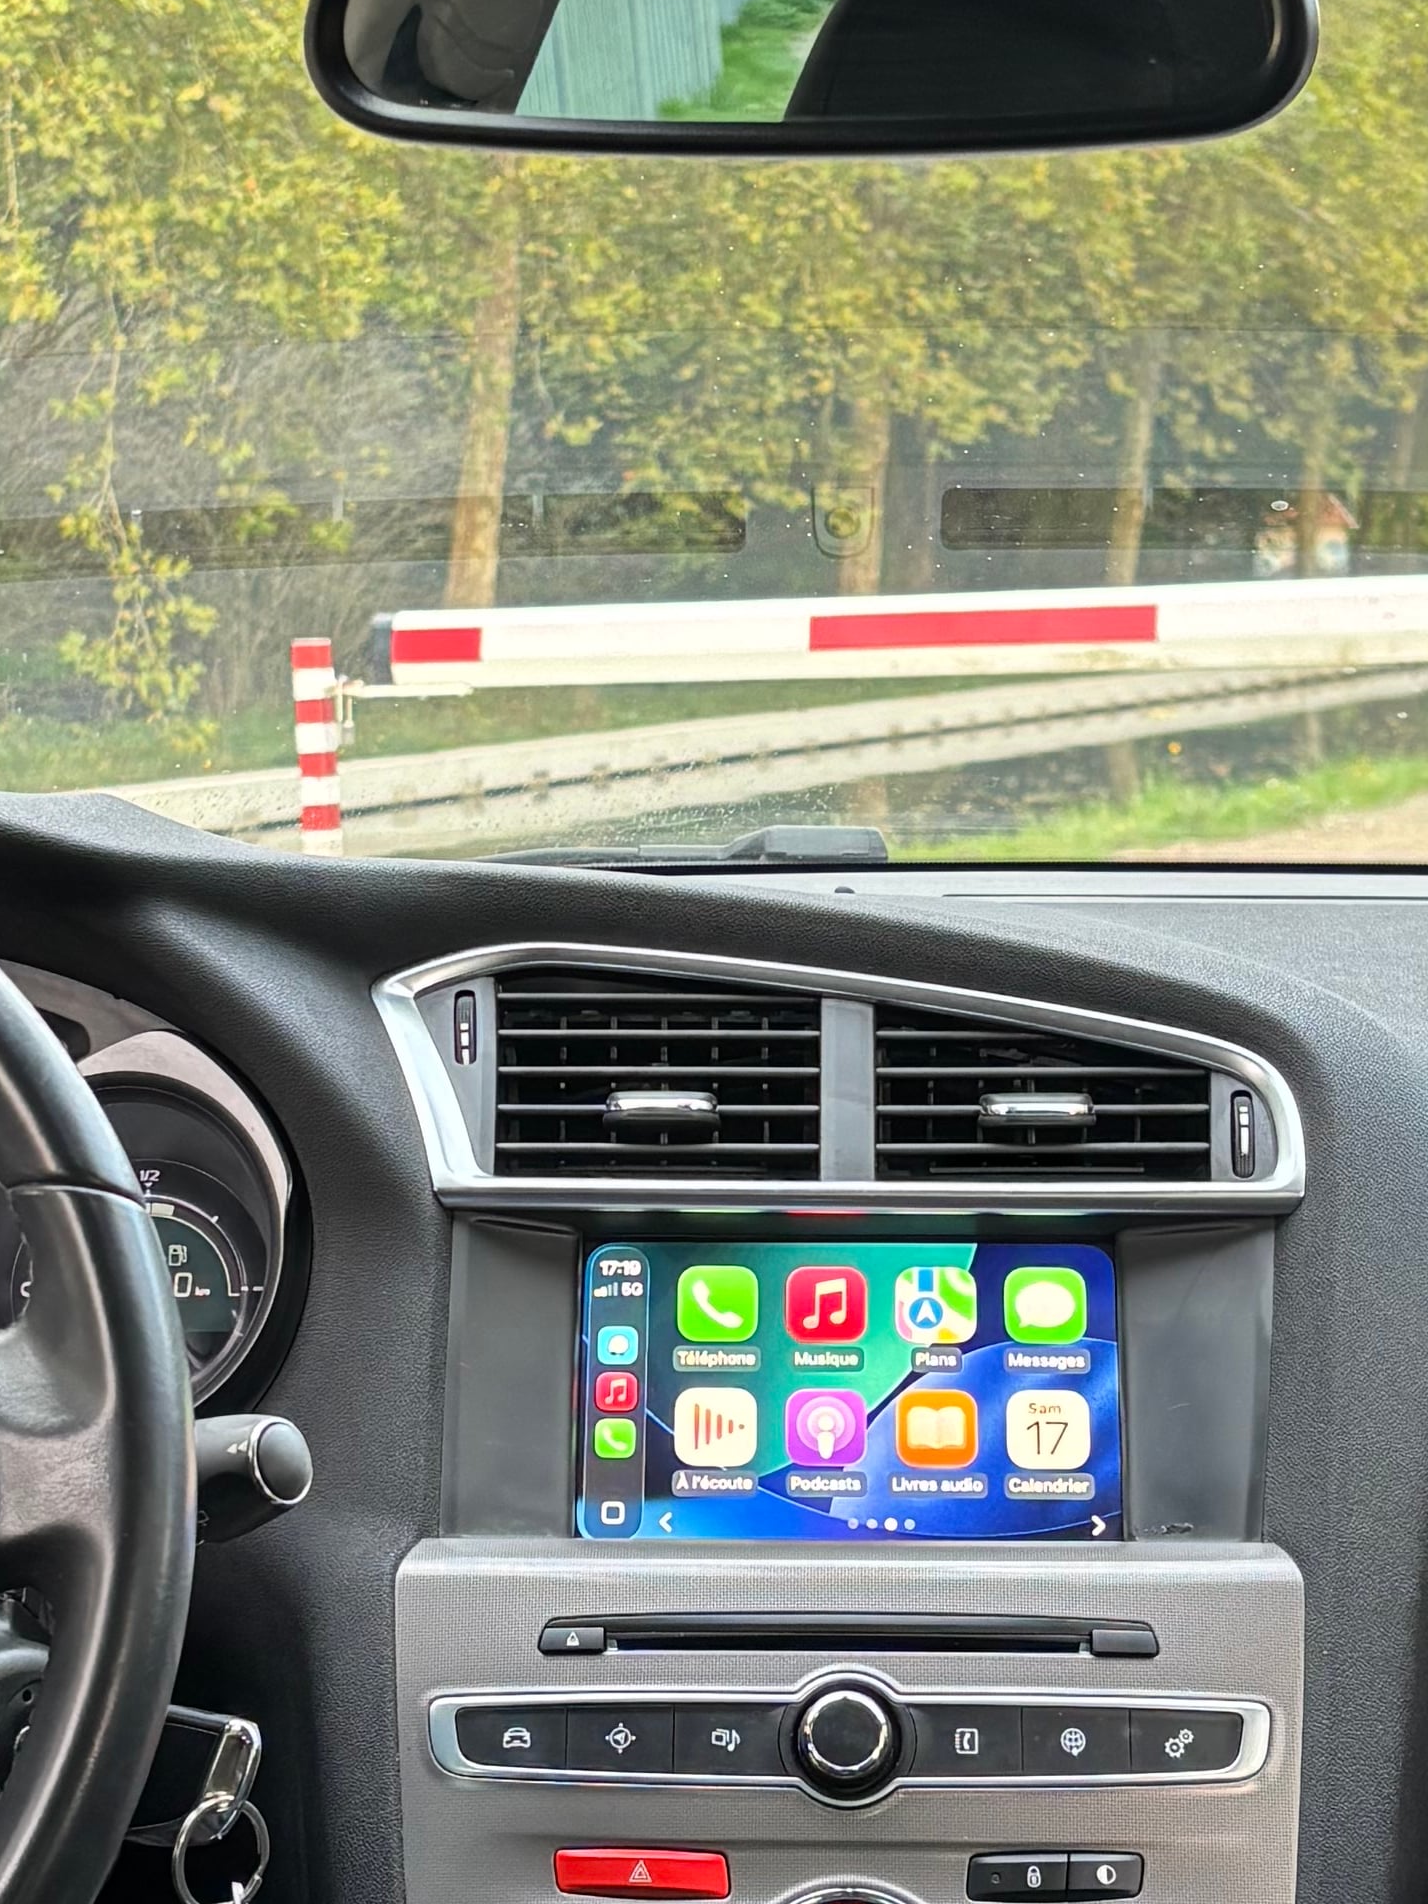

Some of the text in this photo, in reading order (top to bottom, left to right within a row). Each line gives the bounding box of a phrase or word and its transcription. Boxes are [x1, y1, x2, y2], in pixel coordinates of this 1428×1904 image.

[139, 1169, 161, 1182] 1/2
[598, 1259, 642, 1277] 17:19
[621, 1282, 644, 1297] 5G
[676, 1350, 757, 1369] Téléphone
[793, 1351, 860, 1369] Musique
[915, 1352, 958, 1368] Plans
[1007, 1353, 1086, 1370] Messages
[1027, 1402, 1062, 1415] Sam
[1026, 1420, 1069, 1456] 17
[676, 1472, 754, 1491] À l'écoute
[789, 1476, 862, 1492] Podcasts
[891, 1476, 985, 1493] Livres audio
[1008, 1477, 1091, 1494] Calendrier
